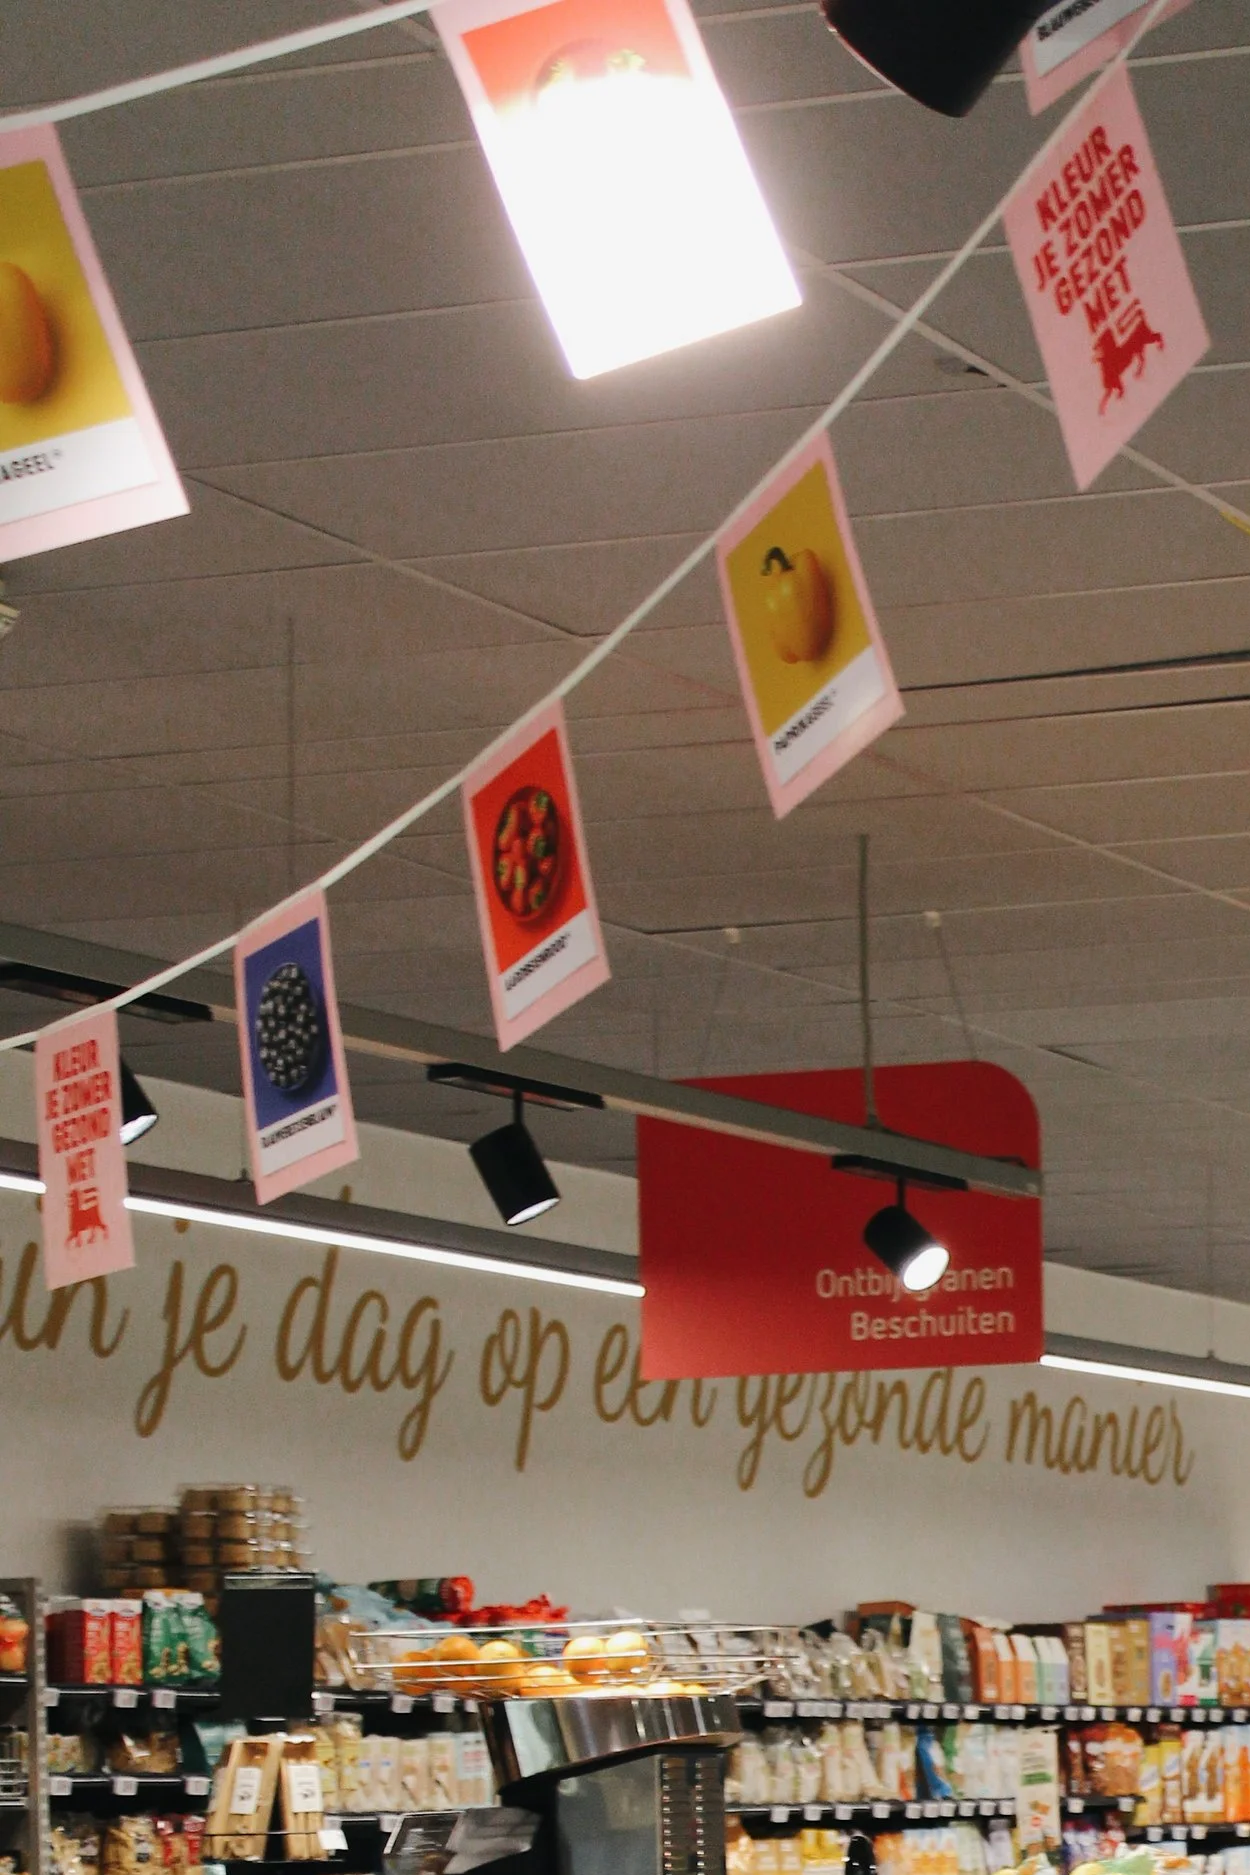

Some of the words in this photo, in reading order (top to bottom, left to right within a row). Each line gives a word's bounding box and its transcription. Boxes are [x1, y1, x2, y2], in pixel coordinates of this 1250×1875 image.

[1033, 241, 1060, 292] JE
[1058, 144, 1140, 257] ZOMER
[1035, 126, 1111, 232] KLEUR
[1055, 189, 1145, 316] GEZOND
[1084, 254, 1131, 334] MET
[135, 1218, 248, 1438] je
[276, 1185, 455, 1462] dag
[480, 1306, 571, 1473] op
[1005, 1382, 1195, 1486] manier
[816, 1267, 1014, 1302] Ontbijanen
[851, 1306, 1015, 1341] Beschuiten
